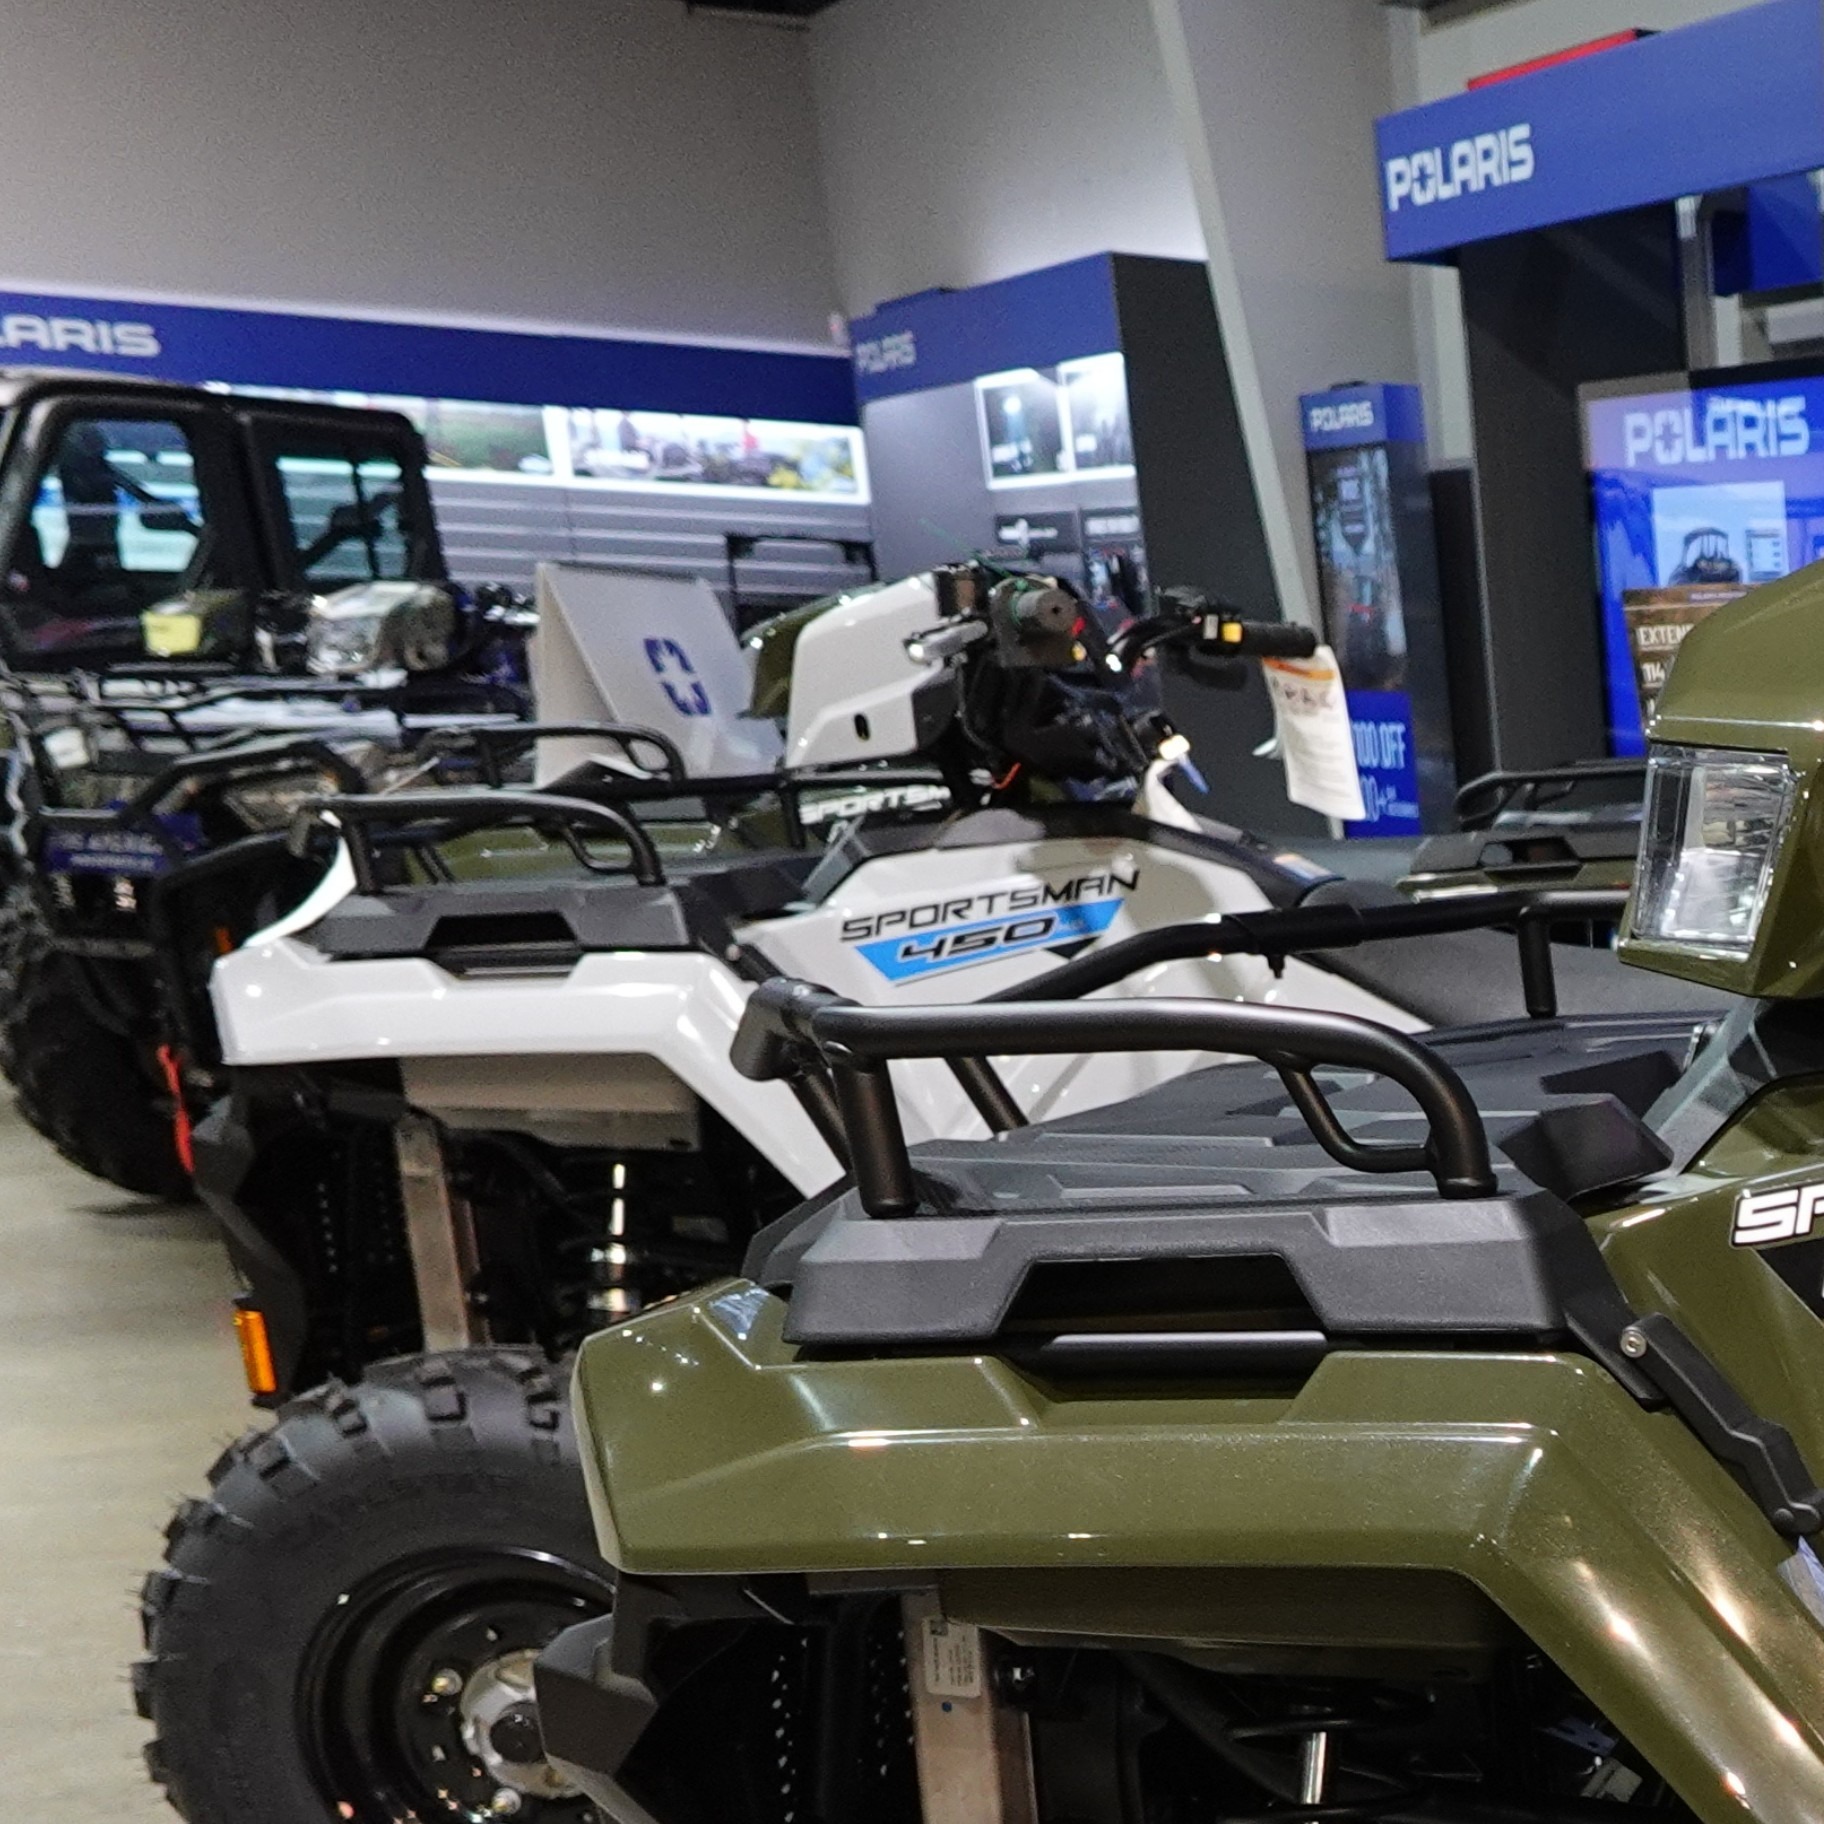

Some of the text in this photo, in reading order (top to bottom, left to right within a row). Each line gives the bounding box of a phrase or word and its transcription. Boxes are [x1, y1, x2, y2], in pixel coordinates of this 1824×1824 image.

[1386, 124, 1535, 211] POLARIS
[1624, 396, 1810, 468] POLARIS
[840, 870, 1140, 942] SPORTSMAN
[900, 916, 1059, 962] 450
